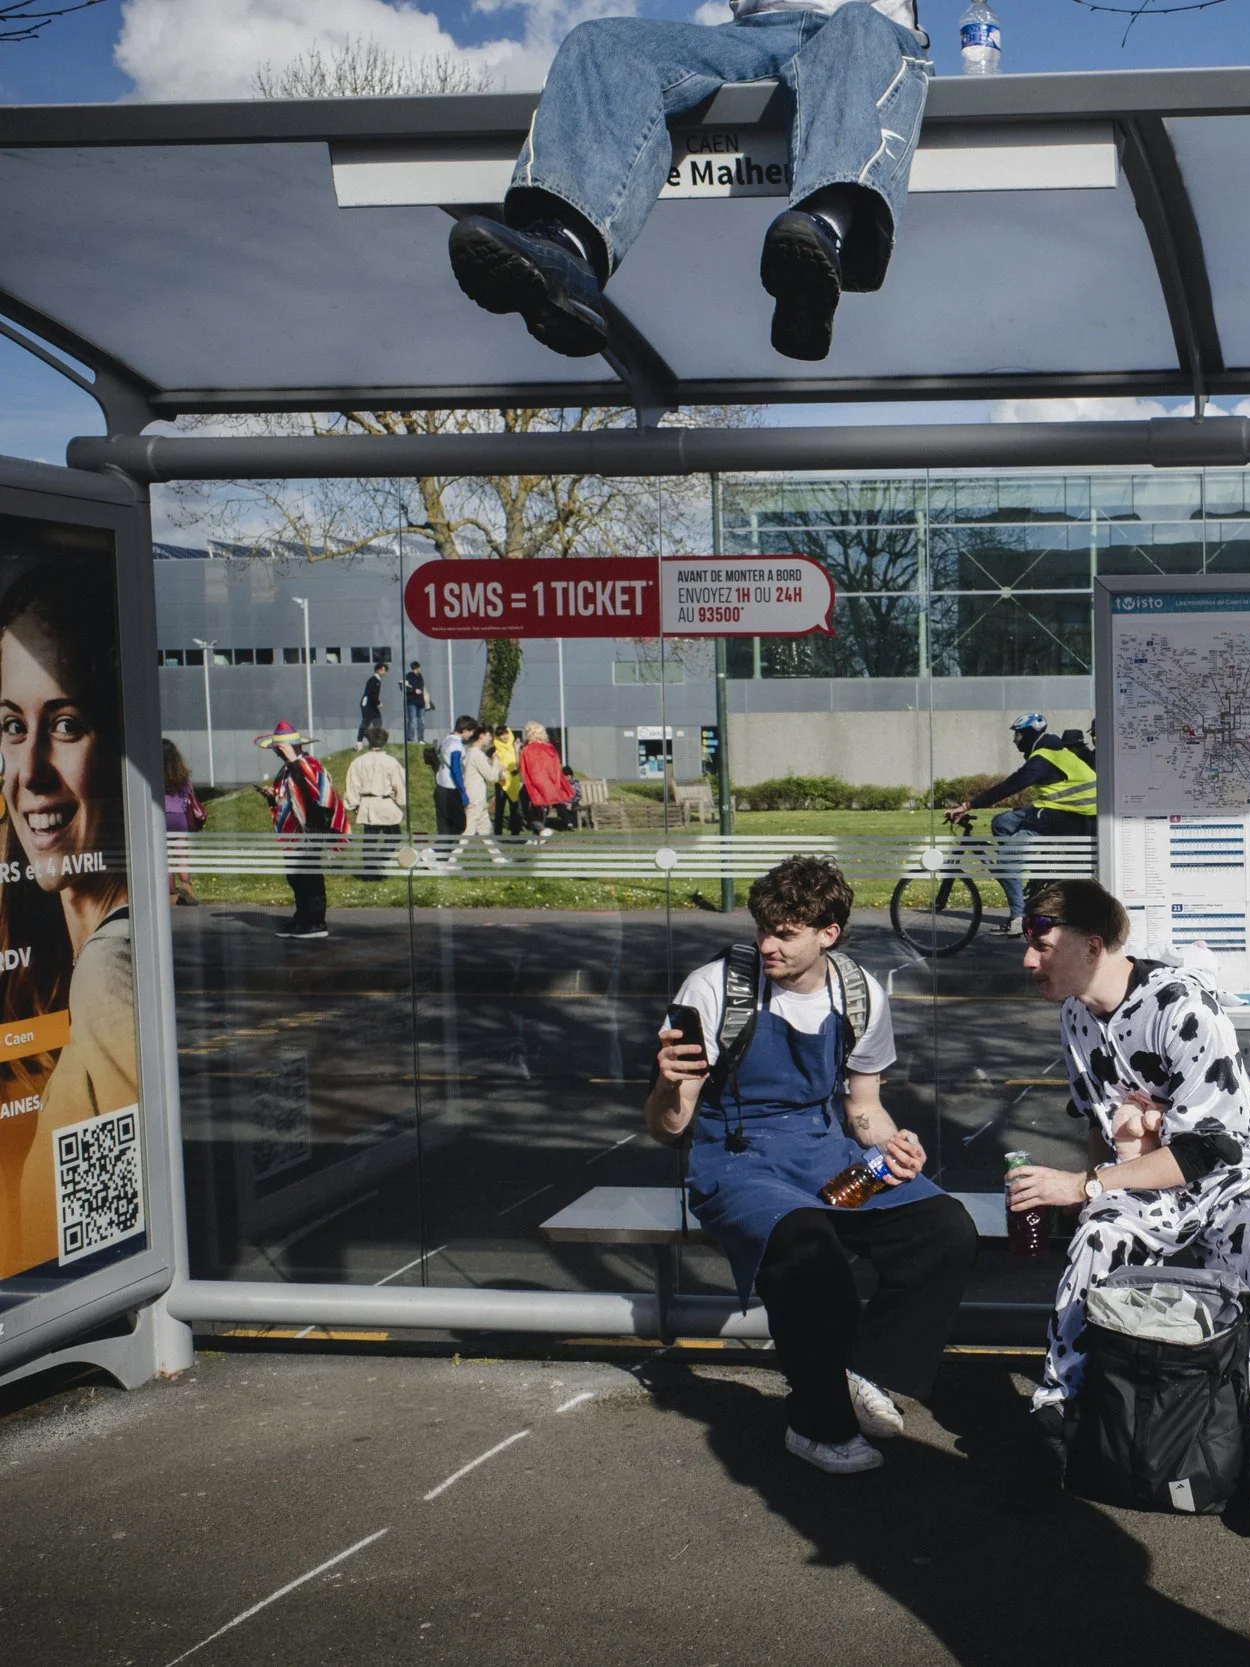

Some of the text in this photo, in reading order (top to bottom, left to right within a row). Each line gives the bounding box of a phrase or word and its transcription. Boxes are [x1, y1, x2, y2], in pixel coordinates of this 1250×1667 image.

[686, 134, 739, 153] CAEN
[677, 569, 802, 583] AVANT DE MONTER A BORD
[424, 582, 436, 618] 1
[443, 582, 504, 618] SMS
[532, 581, 545, 616] 1
[678, 587, 802, 604] ENVOYEZ 1H OU 24H
[1116, 597, 1163, 610] twisto
[678, 607, 694, 623] AU
[25, 859, 42, 880] et
[46, 857, 56, 876] 4
[61, 851, 106, 876] AVRIL
[4, 1031, 34, 1046] Caen
